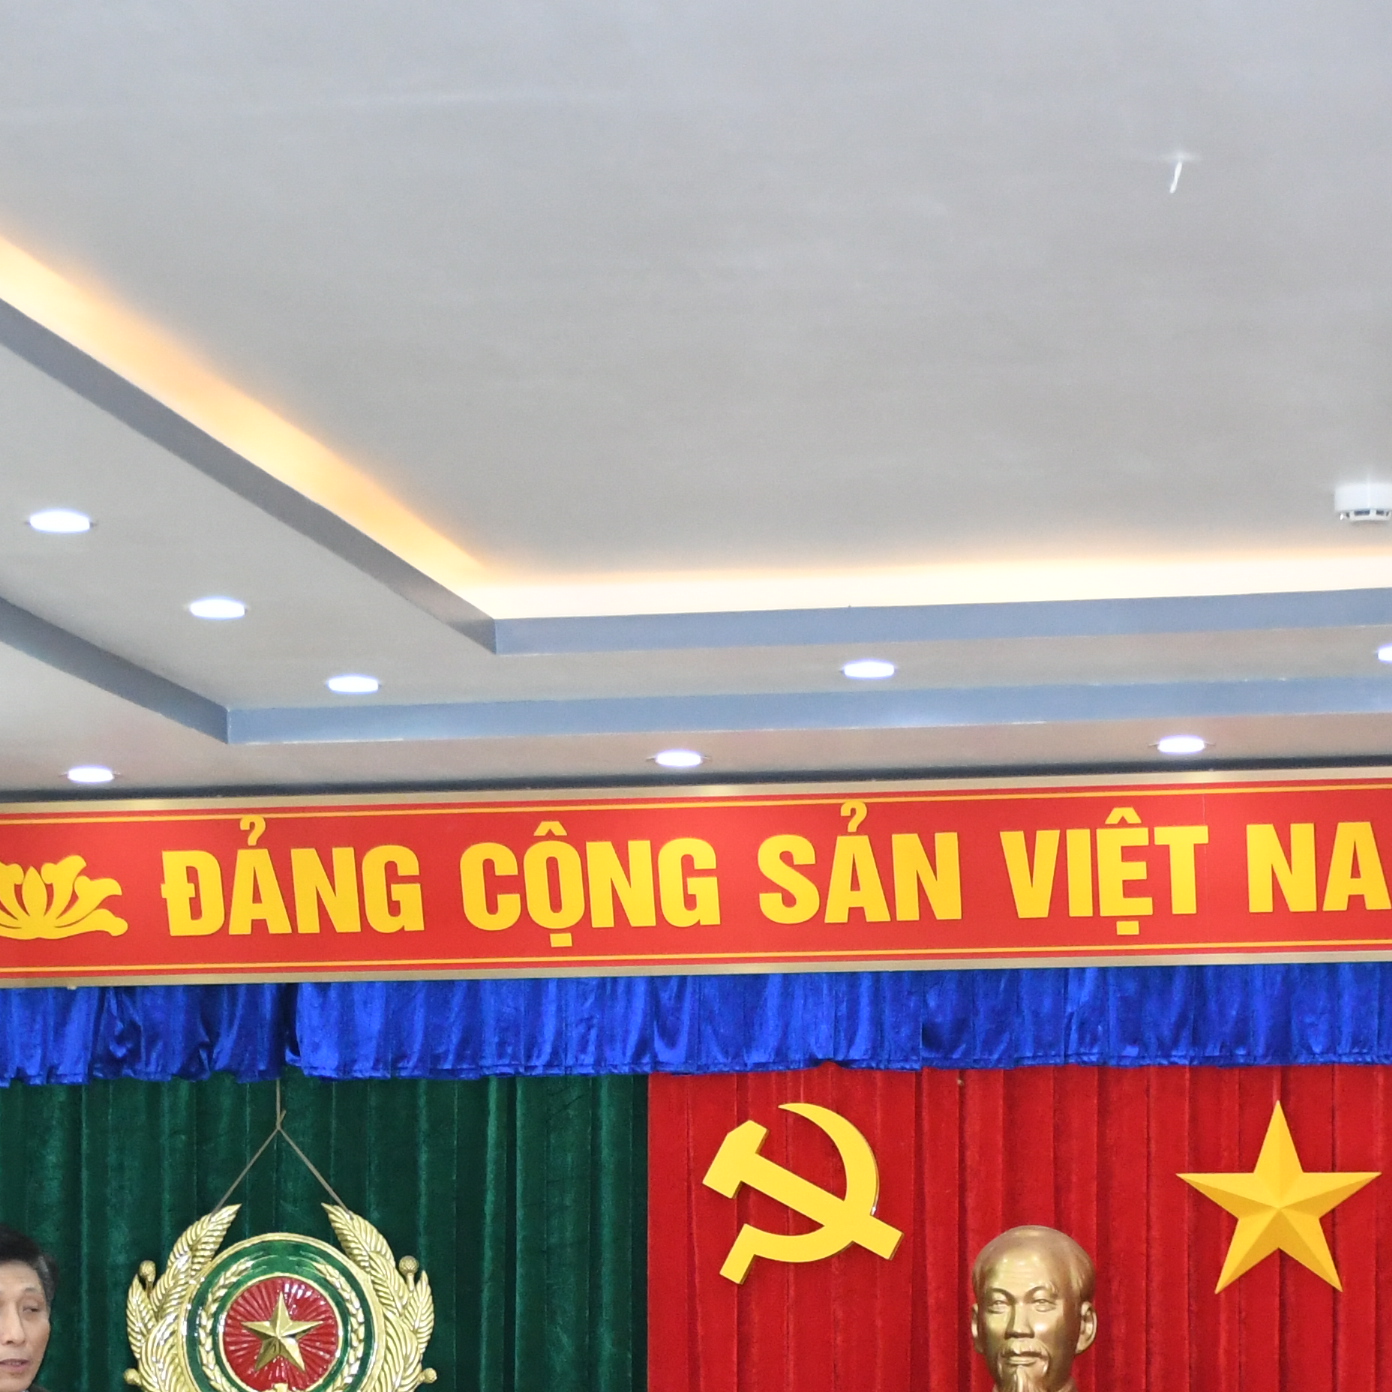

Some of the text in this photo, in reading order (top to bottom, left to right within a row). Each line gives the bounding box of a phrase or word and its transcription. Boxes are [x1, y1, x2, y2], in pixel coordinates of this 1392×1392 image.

[160, 816, 425, 937] ĐẢNG
[459, 820, 721, 948] CỘNG
[757, 800, 963, 925] SẢN
[999, 806, 1210, 936] VIỆT
